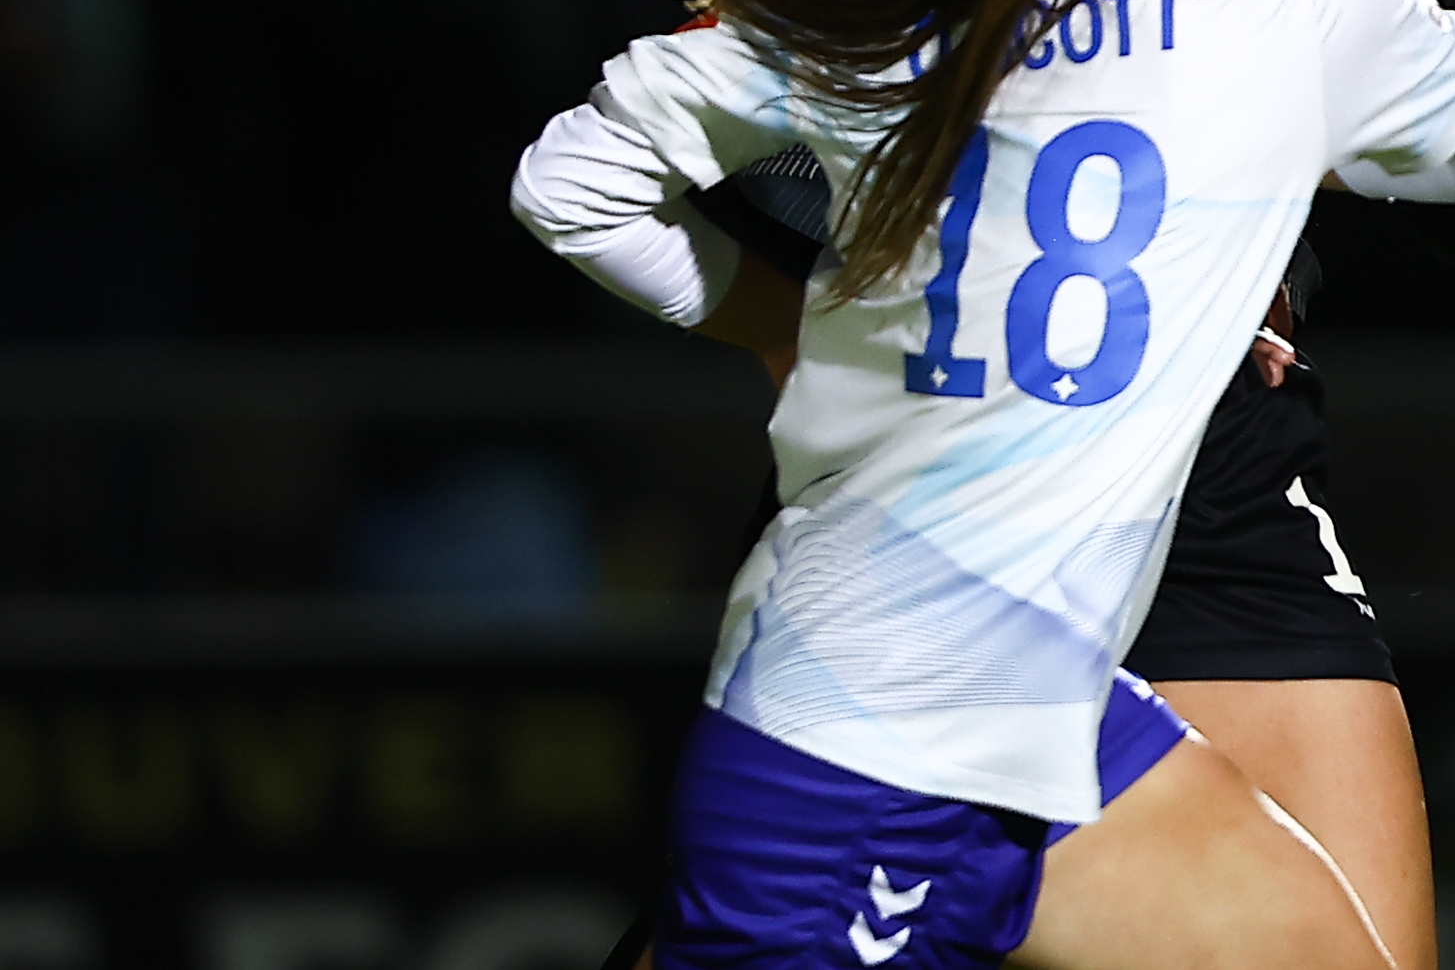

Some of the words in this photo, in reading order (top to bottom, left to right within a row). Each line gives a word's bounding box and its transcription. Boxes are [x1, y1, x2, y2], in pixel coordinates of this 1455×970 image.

[904, 118, 1168, 407] 18
[1284, 475, 1367, 597] 1
[0, 690, 640, 846] UVER
